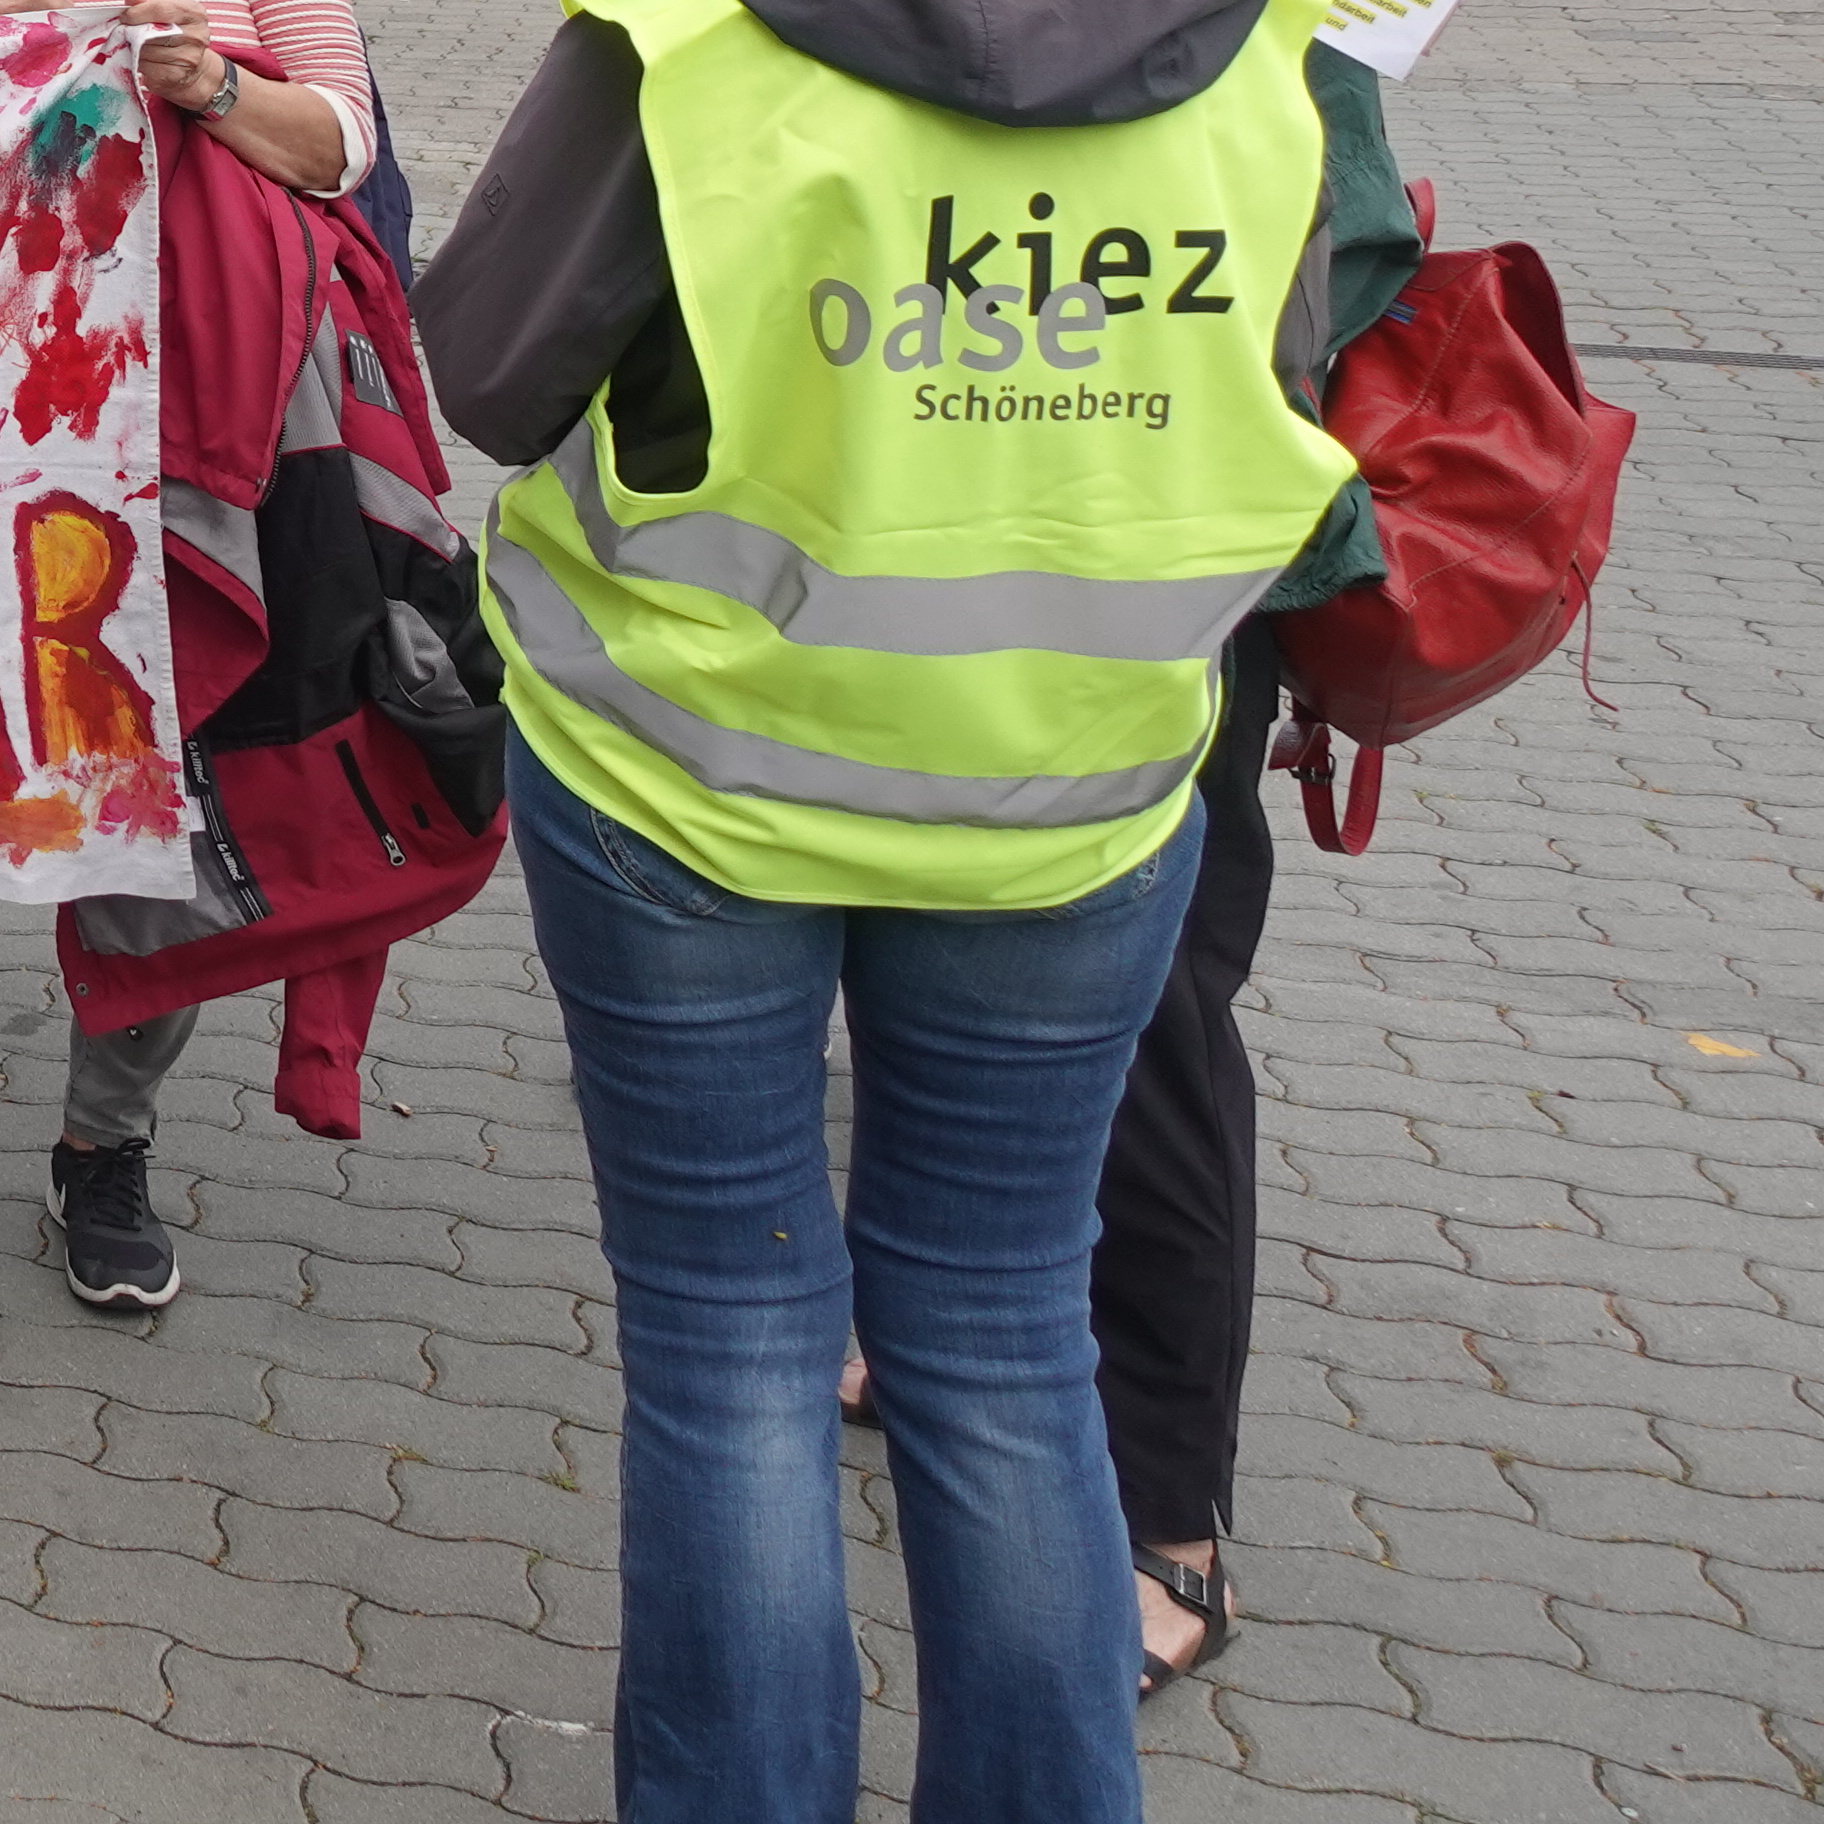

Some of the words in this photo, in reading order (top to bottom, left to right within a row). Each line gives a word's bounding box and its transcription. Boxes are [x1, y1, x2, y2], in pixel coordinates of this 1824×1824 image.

[925, 192, 1235, 317] kiez
[809, 278, 1107, 373] oase
[914, 383, 1171, 430] Schöneberg
